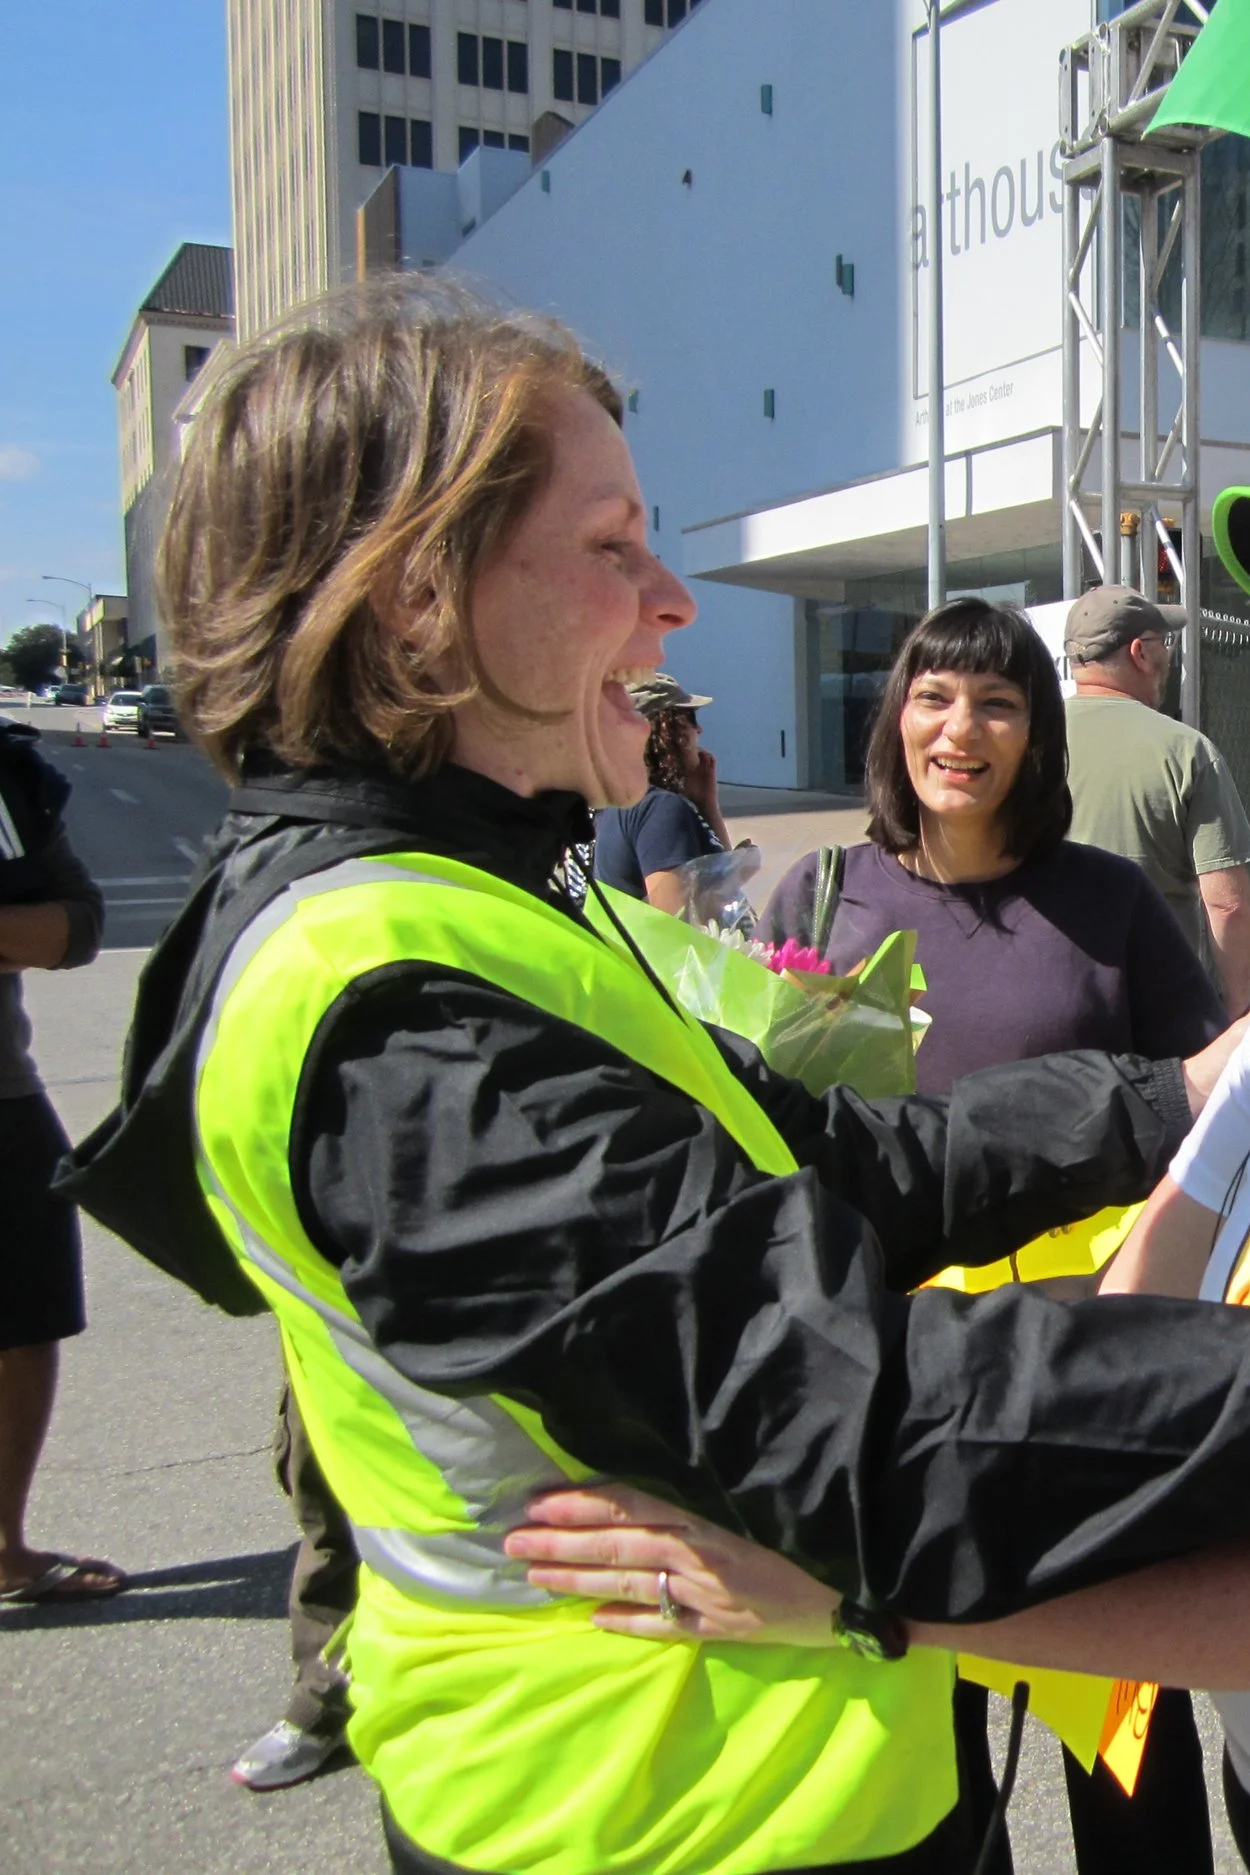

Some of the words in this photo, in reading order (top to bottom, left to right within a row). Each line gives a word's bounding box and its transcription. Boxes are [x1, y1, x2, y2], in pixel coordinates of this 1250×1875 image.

[909, 124, 1096, 271] athous
[954, 396, 965, 414] the
[966, 391, 988, 410] Jones
[988, 382, 1014, 402] Center
